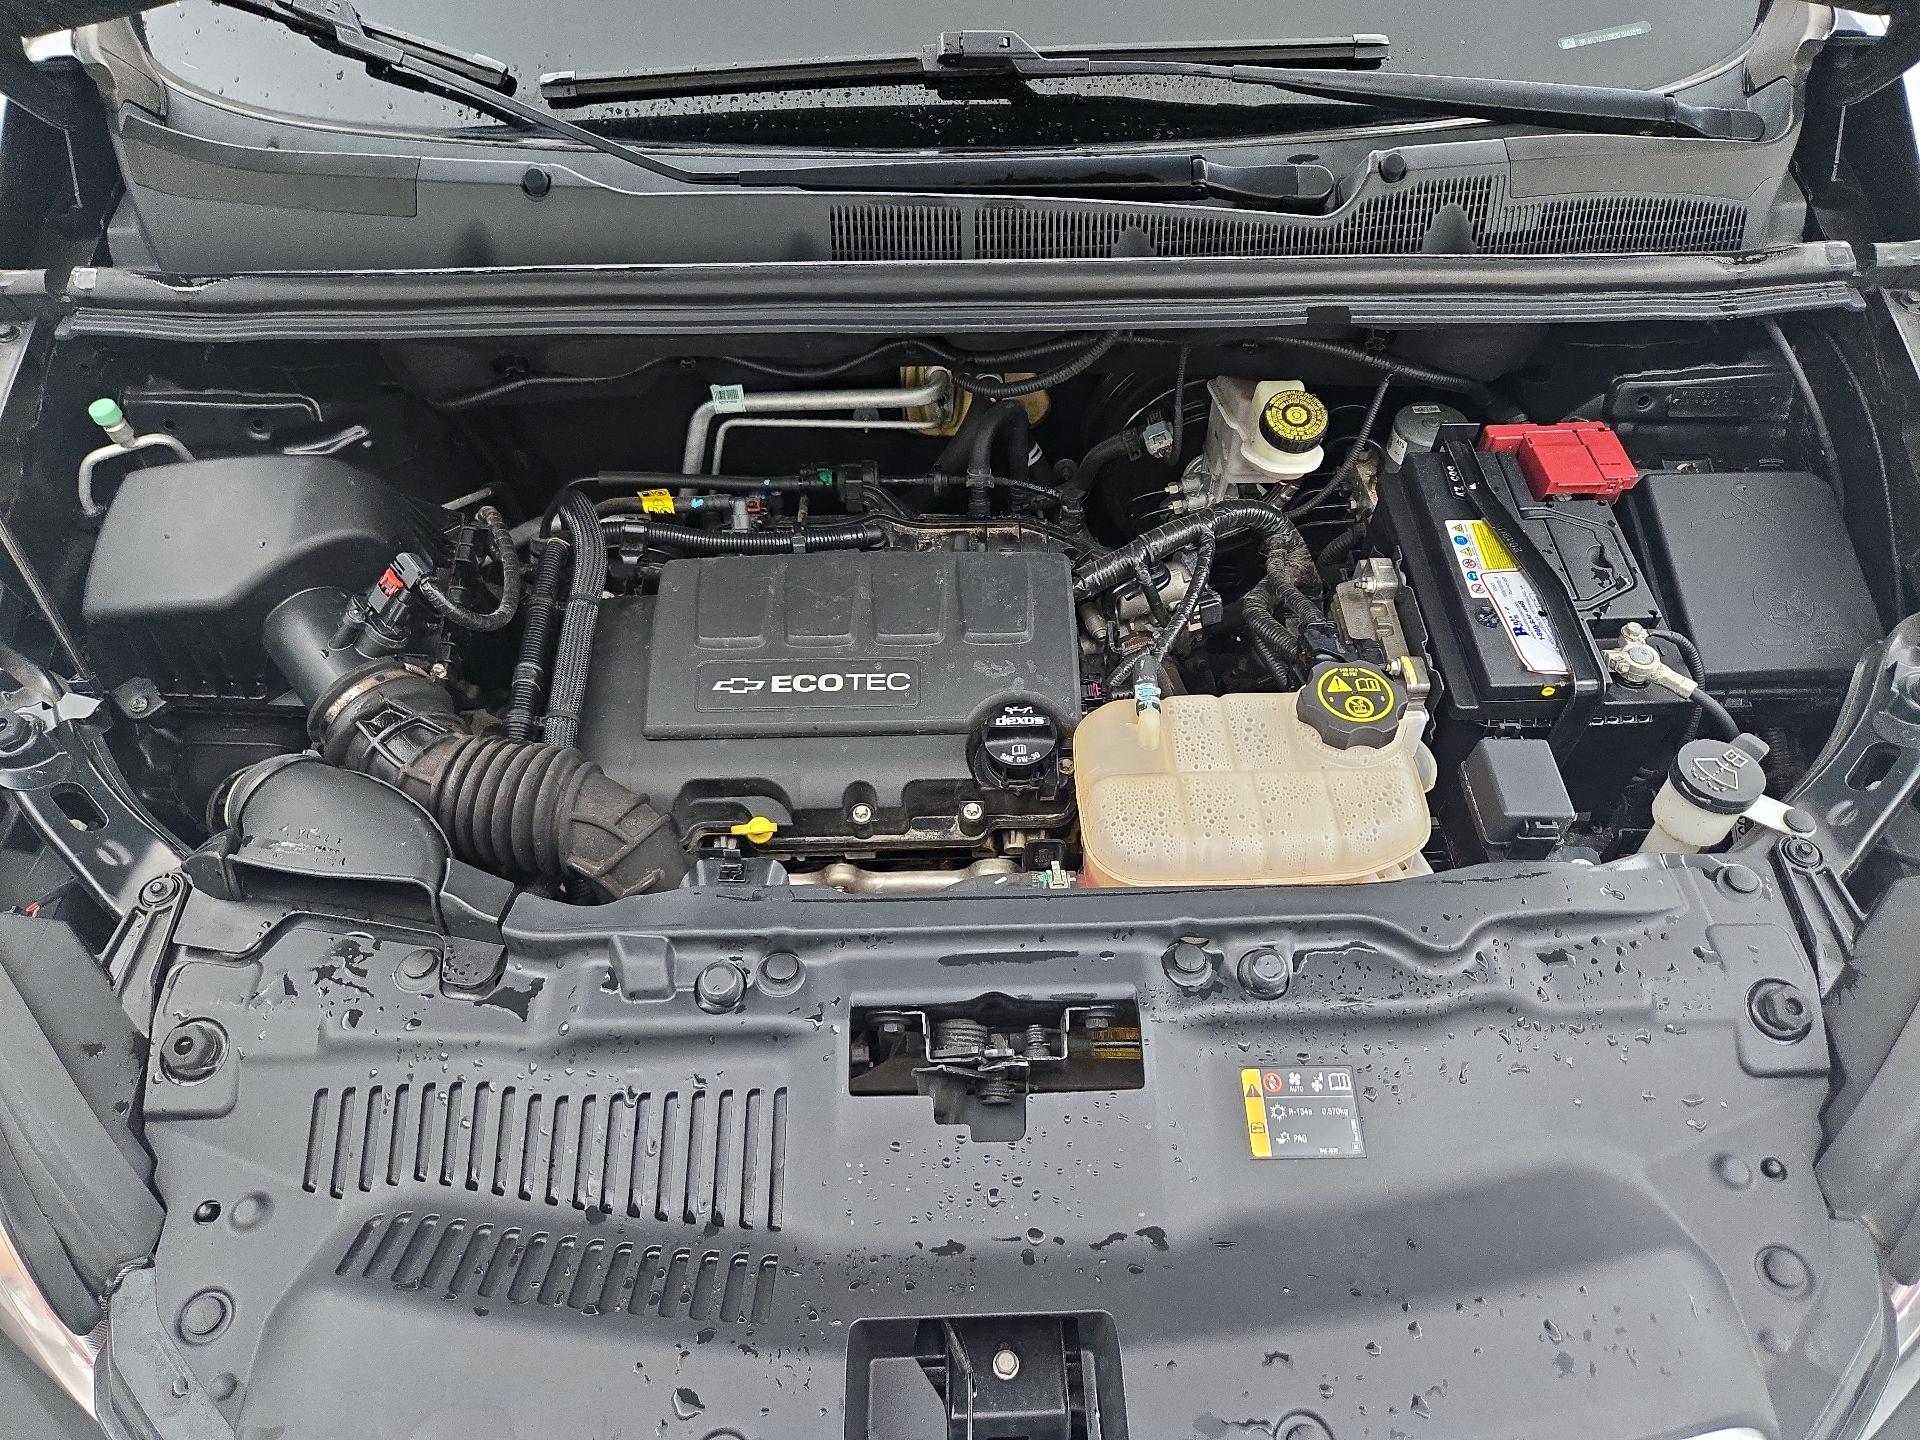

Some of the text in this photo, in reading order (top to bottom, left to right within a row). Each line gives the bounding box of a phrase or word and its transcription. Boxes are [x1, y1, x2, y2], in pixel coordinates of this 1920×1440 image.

[771, 672, 911, 693] ECOTEC
[995, 715, 1045, 726] dexos
[1000, 751, 1041, 763] SAE 5W-30
[1289, 1085, 1304, 1093] AUTO
[1288, 1107, 1313, 1116] R-134a
[1293, 1134, 1308, 1144] PAG
